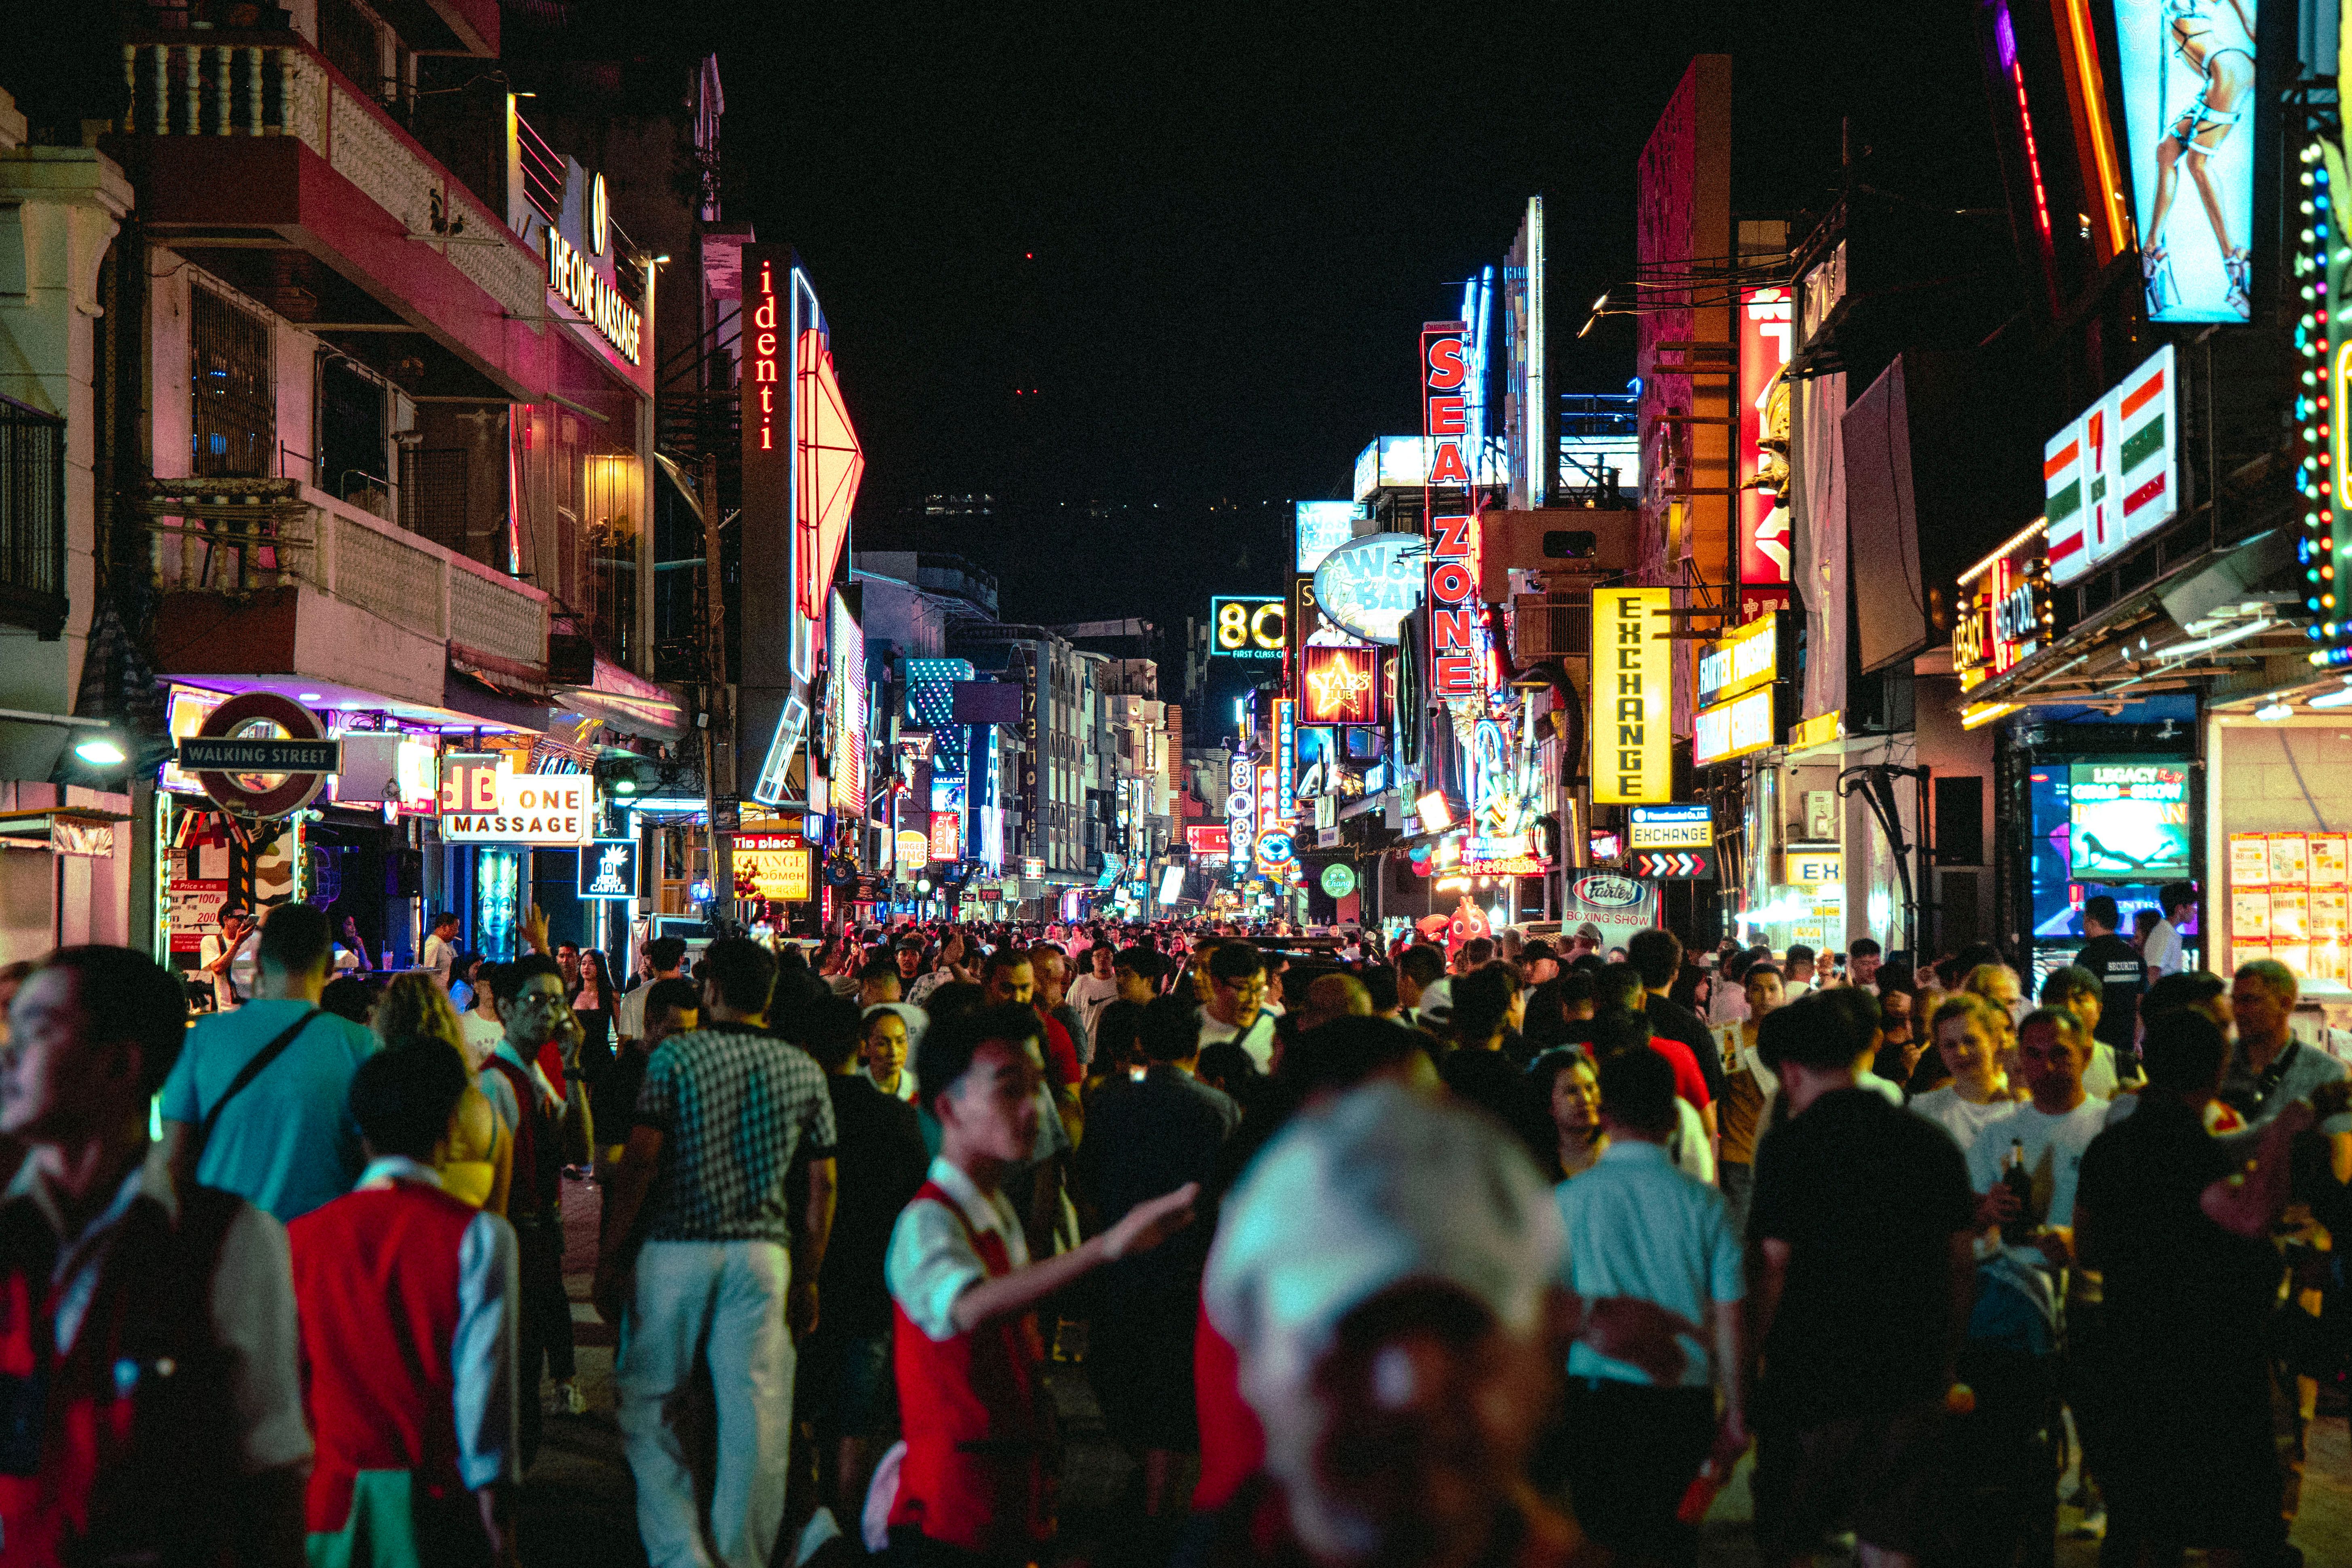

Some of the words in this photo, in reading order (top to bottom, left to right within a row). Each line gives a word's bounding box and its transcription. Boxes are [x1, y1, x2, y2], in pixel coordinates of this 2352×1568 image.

[550, 226, 570, 301] THE
[571, 250, 594, 321] ONE
[595, 275, 641, 366] MASSAGE
[755, 261, 777, 449] identi
[1428, 339, 1470, 483] SEA
[1432, 515, 1474, 696] ZONE
[1233, 650, 1252, 658] FIRST
[1254, 650, 1275, 658] CLASS
[1700, 647, 1732, 696] FAIRTEX
[1307, 671, 1371, 691] STARS
[1325, 690, 1353, 700] CLUB
[1616, 597, 1644, 797] EXCHANGE
[1280, 702, 1293, 744] KING
[188, 747, 266, 762] WALKING
[272, 748, 326, 764] STREET
[1279, 747, 1295, 819] SEAFOOD
[2093, 768, 2158, 783] LEGACY
[520, 790, 579, 809] ONE
[453, 816, 577, 832] MASSAGE
[758, 836, 796, 848] place
[1635, 828, 1707, 842] EXCHANGE
[734, 855, 804, 867] CHANGE
[596, 876, 621, 885] HIGH
[761, 870, 804, 880] обмен
[590, 884, 626, 893] CASTLE
[1325, 879, 1350, 888] Chang
[1589, 879, 1633, 901] Fairtex
[197, 913, 216, 923] 200
[1566, 911, 1610, 923] BOXING
[1614, 914, 1649, 926] SHOW
[2108, 961, 2139, 971] SECURITY
